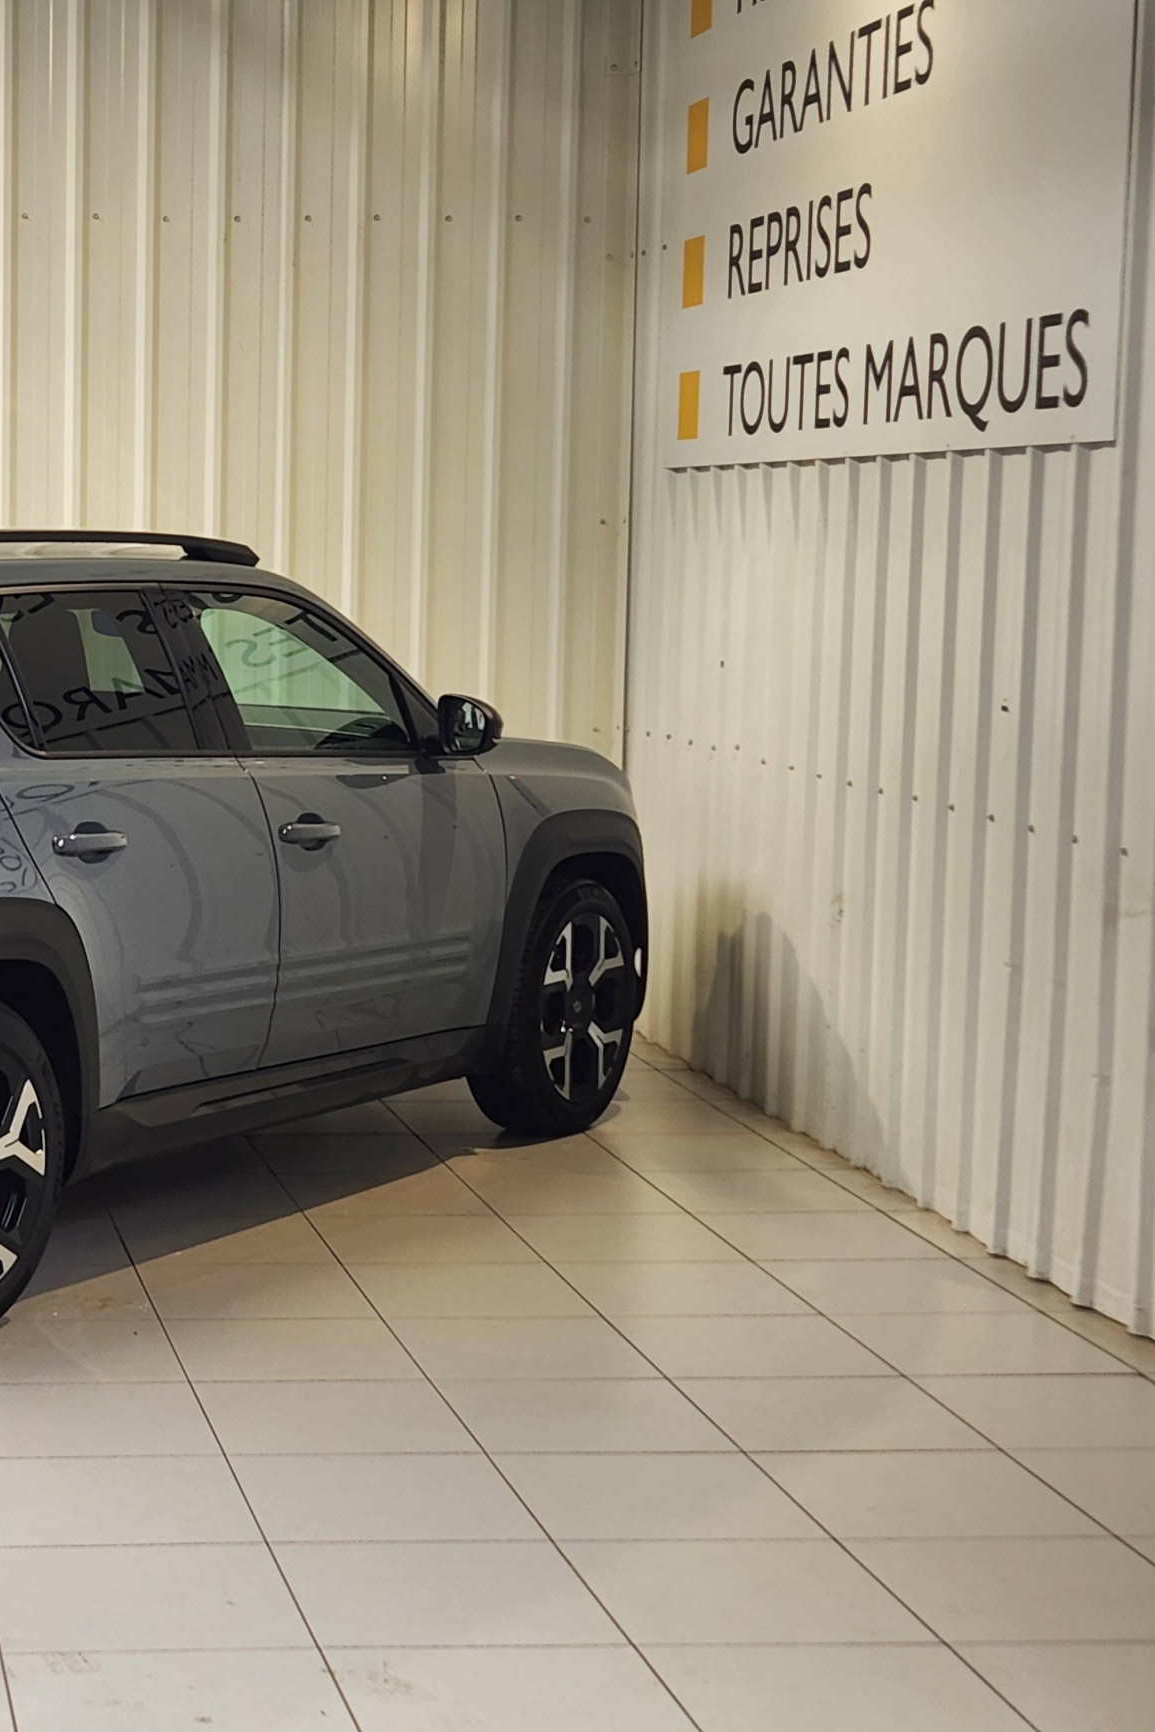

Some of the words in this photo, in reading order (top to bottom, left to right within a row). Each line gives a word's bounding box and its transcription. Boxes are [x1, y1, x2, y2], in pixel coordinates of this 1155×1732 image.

[732, 0, 935, 154] GARANTIES
[728, 183, 872, 299] REPRISES
[723, 347, 850, 436] TOUTES
[863, 309, 1090, 433] MARQUES
